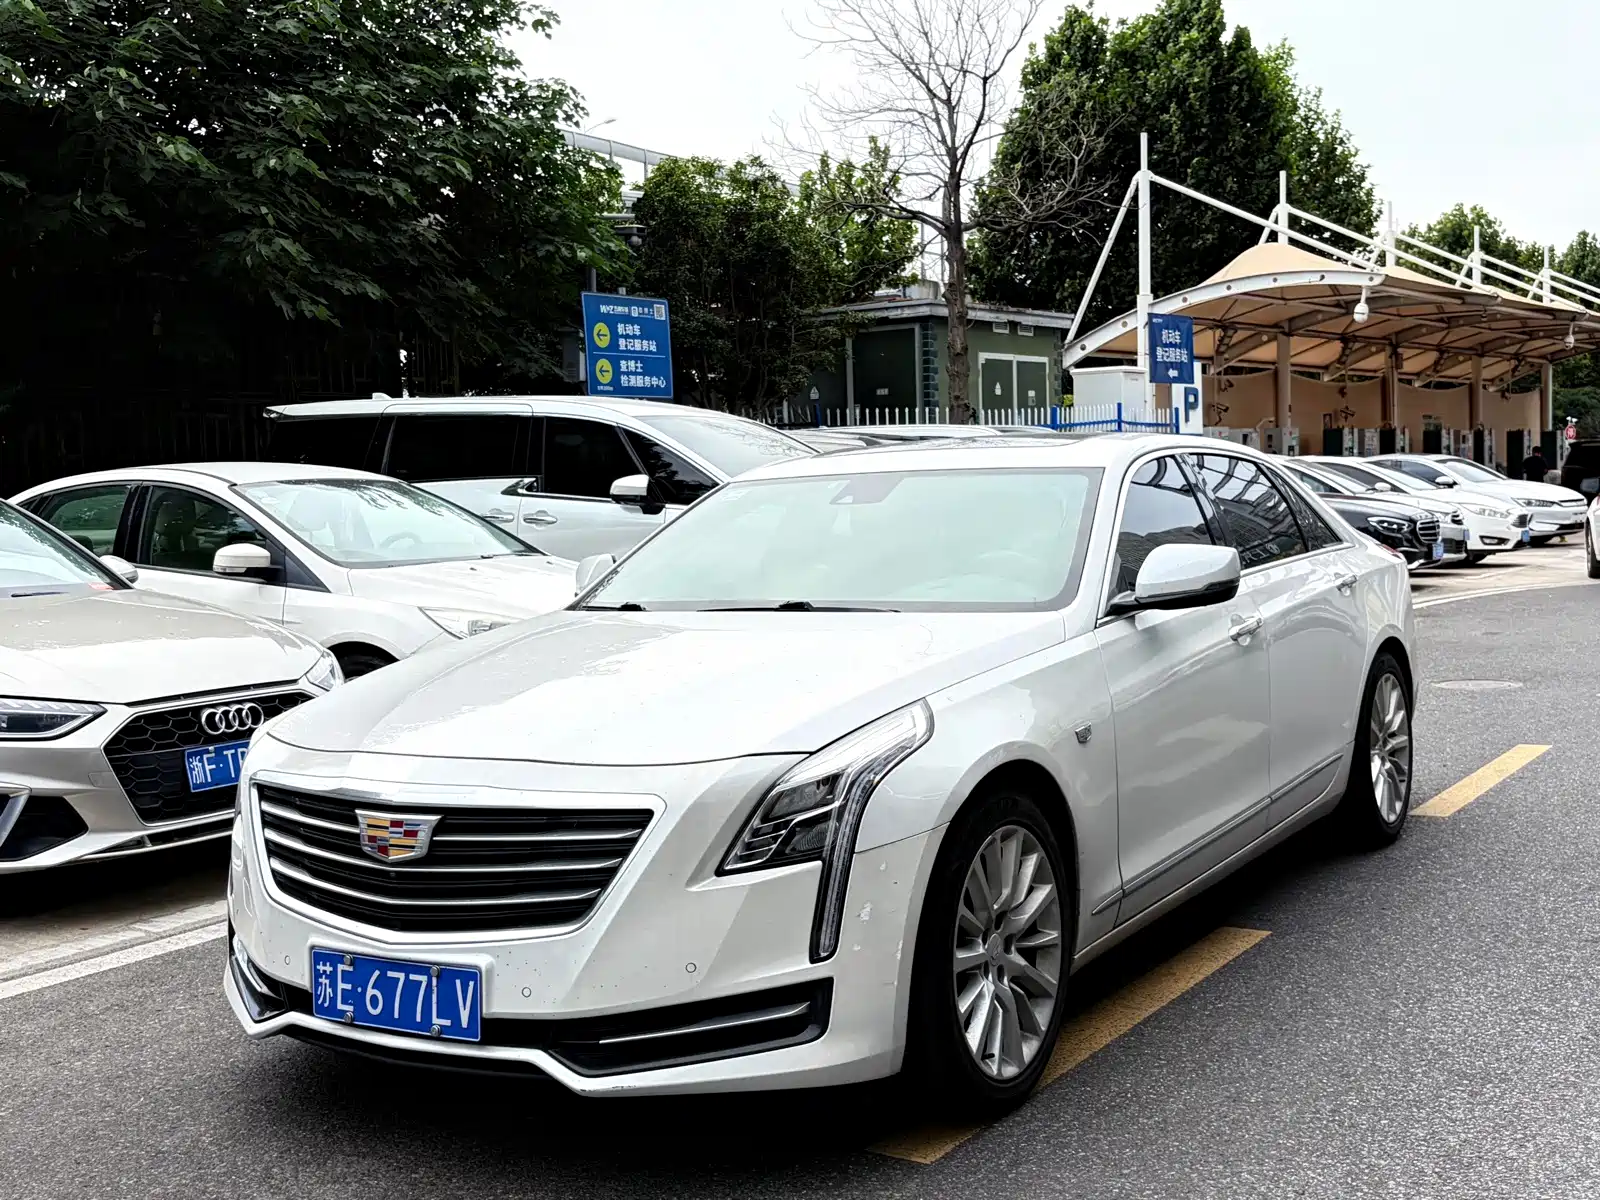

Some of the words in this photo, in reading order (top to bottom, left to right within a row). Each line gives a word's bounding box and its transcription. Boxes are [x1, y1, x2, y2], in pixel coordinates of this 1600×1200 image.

[617, 323, 641, 335] 机动车
[1161, 329, 1181, 344] 机动车
[618, 338, 657, 351] 登记服务站
[1156, 347, 1188, 363] 登记服务站
[620, 360, 643, 372] 查博士
[621, 375, 666, 388] 检测服务中心
[1184, 387, 1199, 423] P
